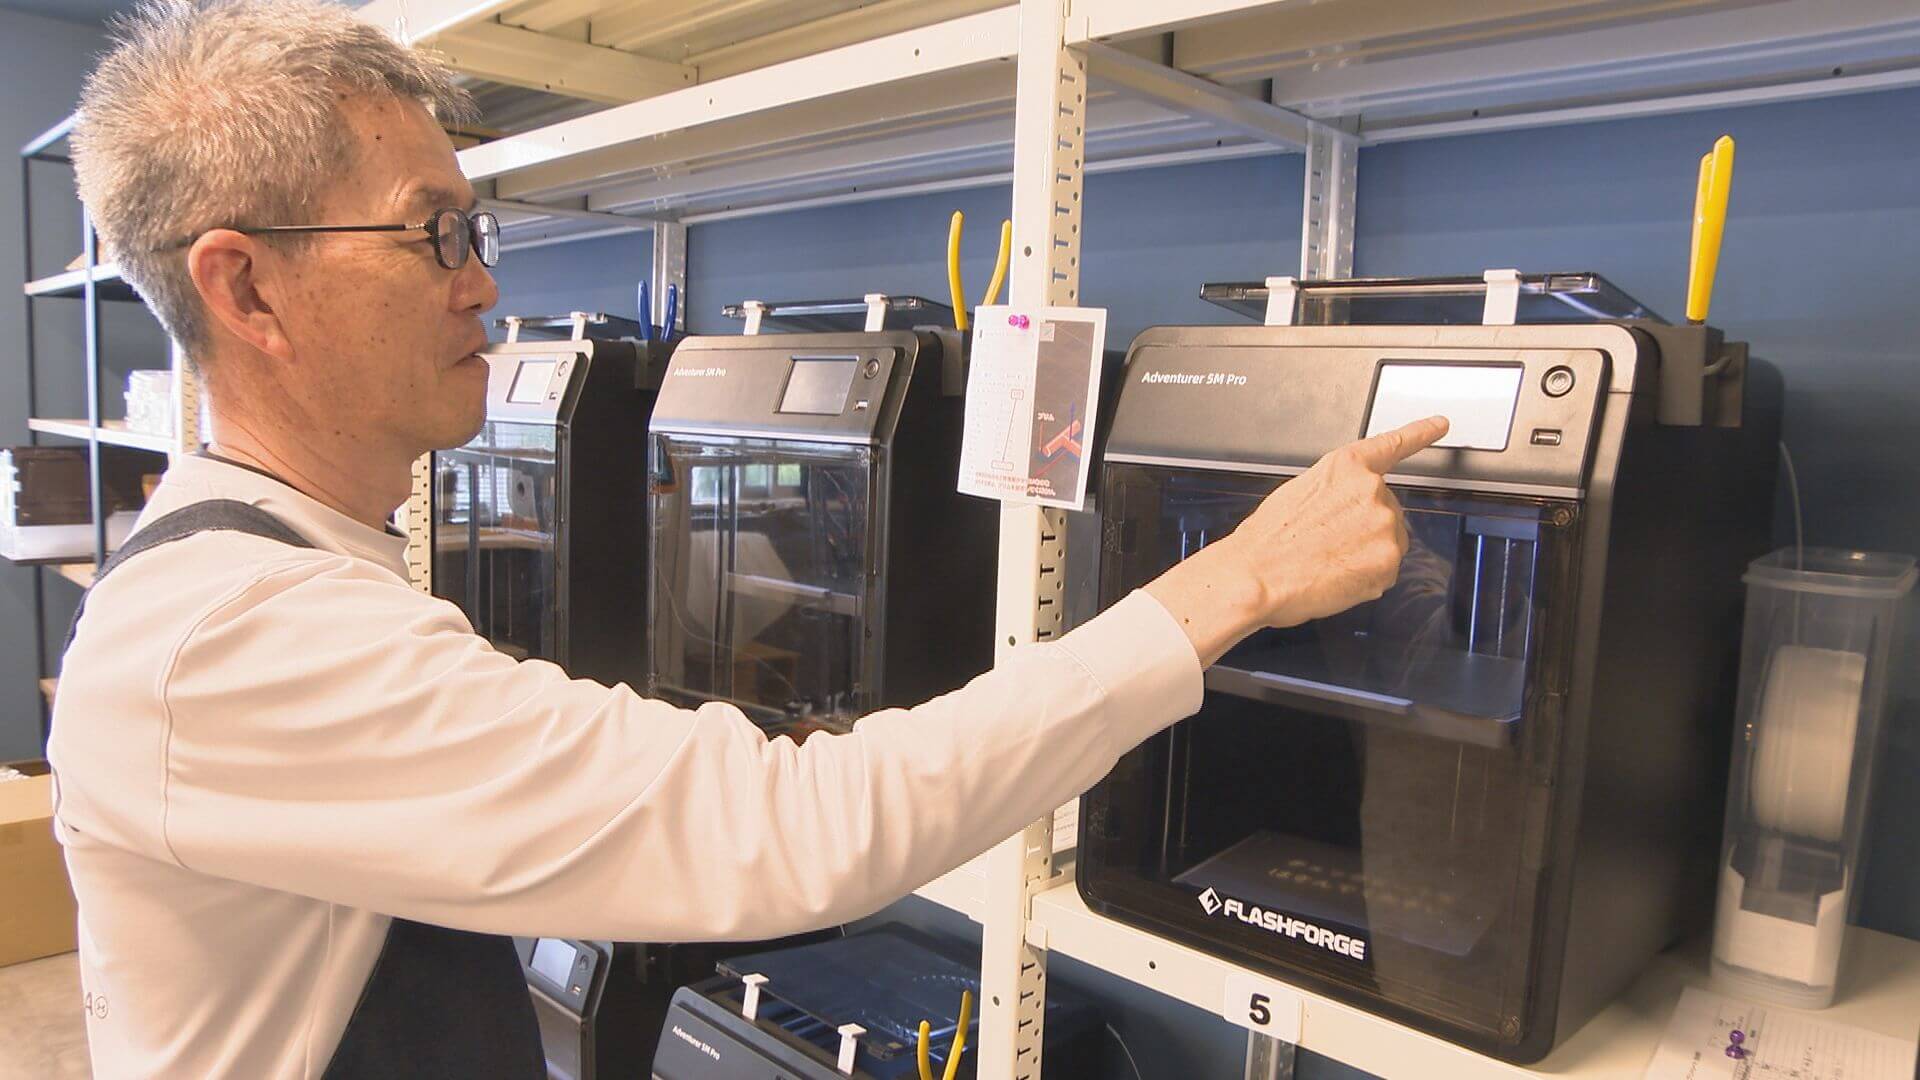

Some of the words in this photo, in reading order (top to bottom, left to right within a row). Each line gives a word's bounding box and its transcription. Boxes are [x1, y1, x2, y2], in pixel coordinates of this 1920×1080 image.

[1141, 371, 1205, 385] Adventurer
[1226, 373, 1247, 386] Pro
[1224, 899, 1366, 961] FLASHFORGE
[1249, 993, 1272, 1025] 5
